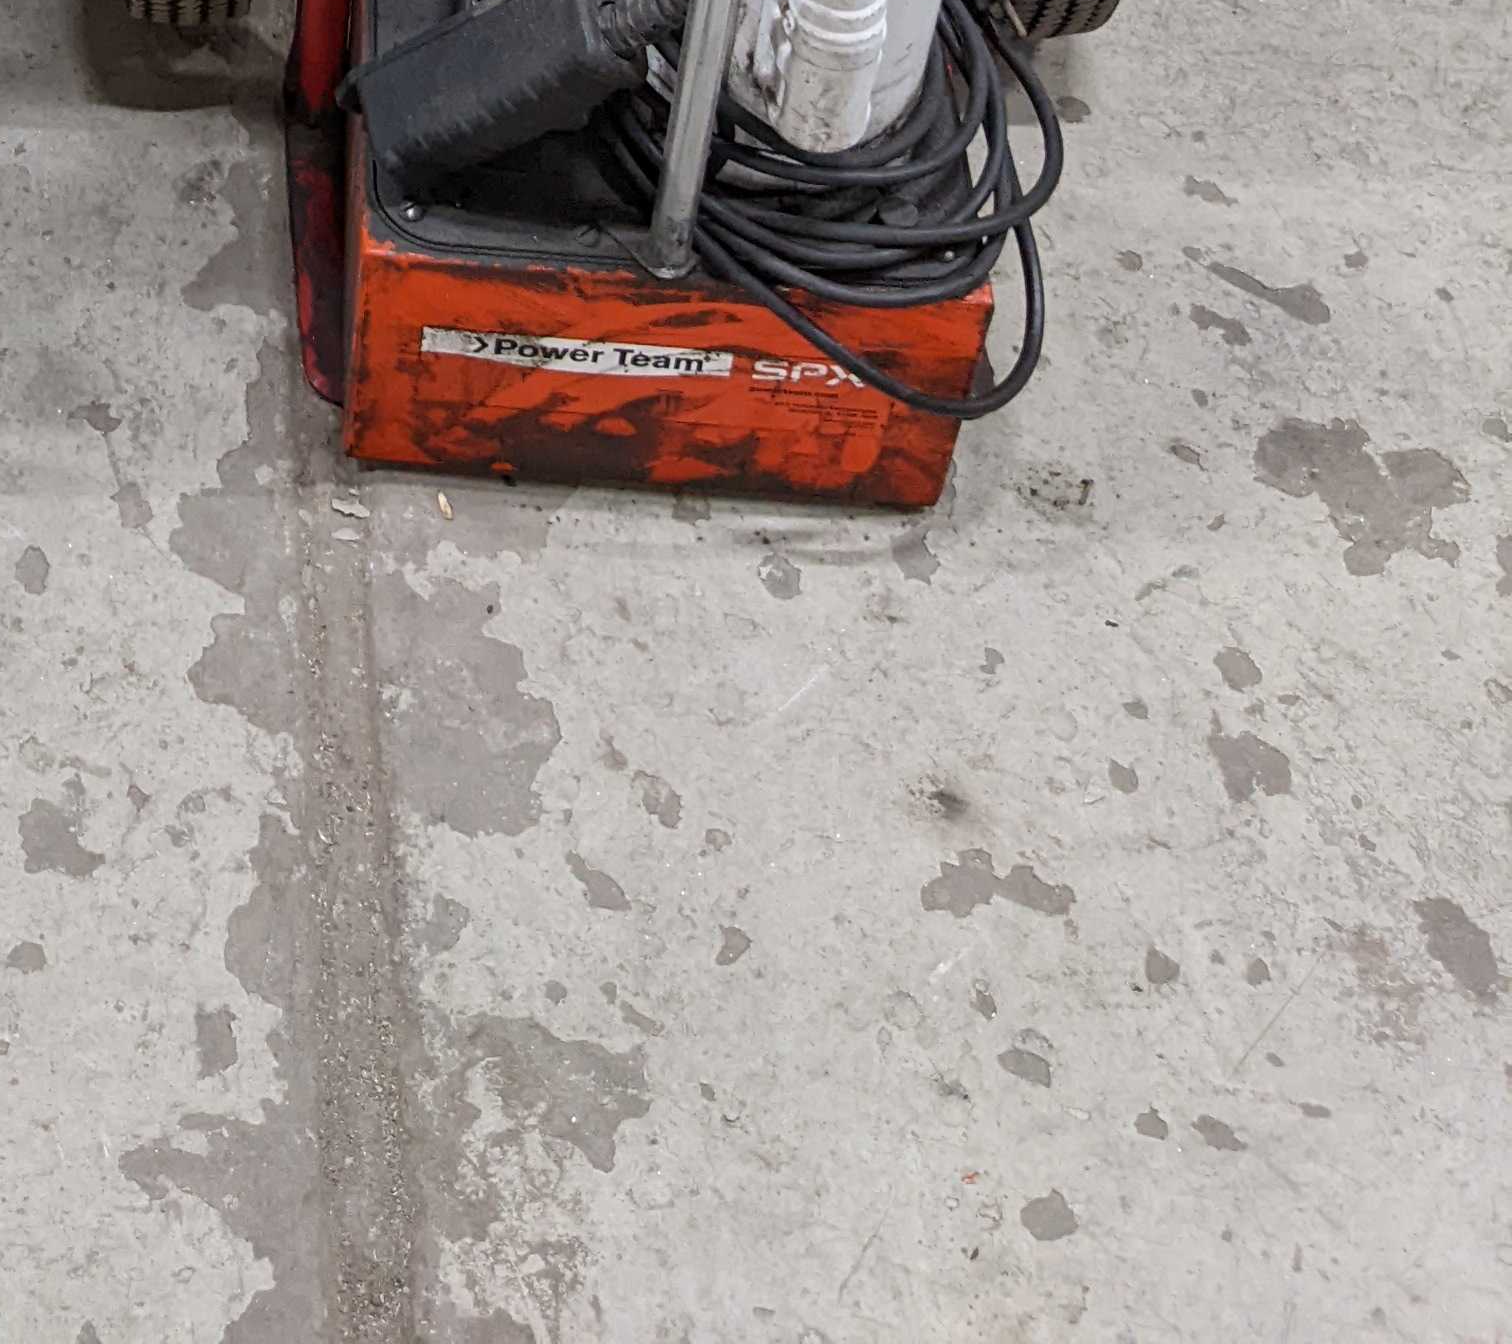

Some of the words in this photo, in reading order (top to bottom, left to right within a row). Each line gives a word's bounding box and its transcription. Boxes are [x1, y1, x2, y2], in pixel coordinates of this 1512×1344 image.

[493, 337, 605, 363] Power
[613, 347, 704, 372] Team
[751, 360, 865, 388] SPX
